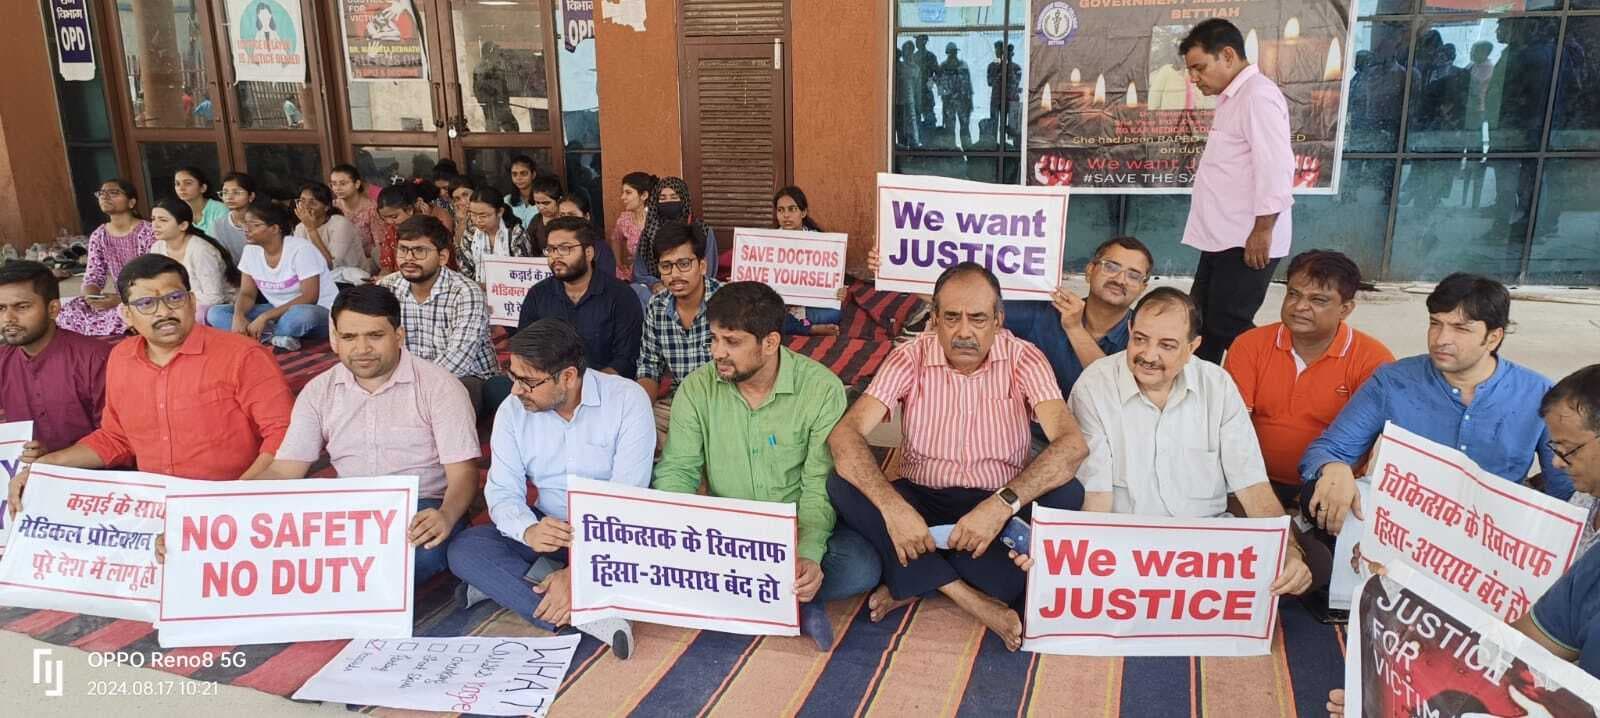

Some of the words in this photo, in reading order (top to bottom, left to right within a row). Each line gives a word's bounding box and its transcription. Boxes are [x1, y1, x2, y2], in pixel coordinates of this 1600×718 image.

[1171, 8, 1240, 19] BETTIAH
[60, 26, 86, 51] OPD
[1072, 135, 1095, 144] She
[1098, 135, 1120, 144] had
[1124, 134, 1155, 144] been
[1179, 145, 1204, 154] dut
[1083, 173, 1137, 183] #SAVE
[1141, 173, 1173, 183] THE
[1087, 158, 1120, 170] We
[1126, 159, 1180, 170] want
[892, 200, 944, 231] We
[956, 208, 1047, 237] want
[741, 244, 774, 263] SAVE
[778, 247, 839, 268] DOCTORS
[889, 238, 1047, 276] JUSTICE
[736, 265, 769, 283] SAVE
[773, 267, 840, 288] YOURSELF
[66, 492, 113, 517] कड़ाई
[113, 493, 133, 516] के
[1378, 463, 1465, 527] चिकित्सक
[1463, 504, 1481, 538] के
[1482, 513, 1557, 577] खिलाफ
[18, 514, 85, 544] मेडिकल
[181, 514, 237, 552] NO
[250, 509, 398, 549] SAFETY
[582, 514, 677, 549] चिकित्सक
[681, 525, 701, 552] के
[706, 528, 787, 563] खिलाफ
[32, 550, 55, 580] पूरे
[57, 552, 87, 577] देश
[89, 555, 107, 579] में
[107, 563, 143, 592] लागू
[140, 561, 158, 588] हो
[202, 560, 258, 598] NO
[271, 556, 376, 595] DUTY
[1043, 539, 1117, 577] We
[1132, 546, 1257, 579] want
[723, 568, 753, 597] बंद
[757, 573, 781, 604] हो
[1039, 587, 1256, 621] JUSTICE
[1477, 569, 1509, 612] बंद
[1504, 587, 1532, 624] हो
[1372, 617, 1420, 671] FOR
[1377, 592, 1513, 687] JUSTICE
[499, 646, 572, 713] WHAT
[1373, 649, 1441, 718] VICTIM
